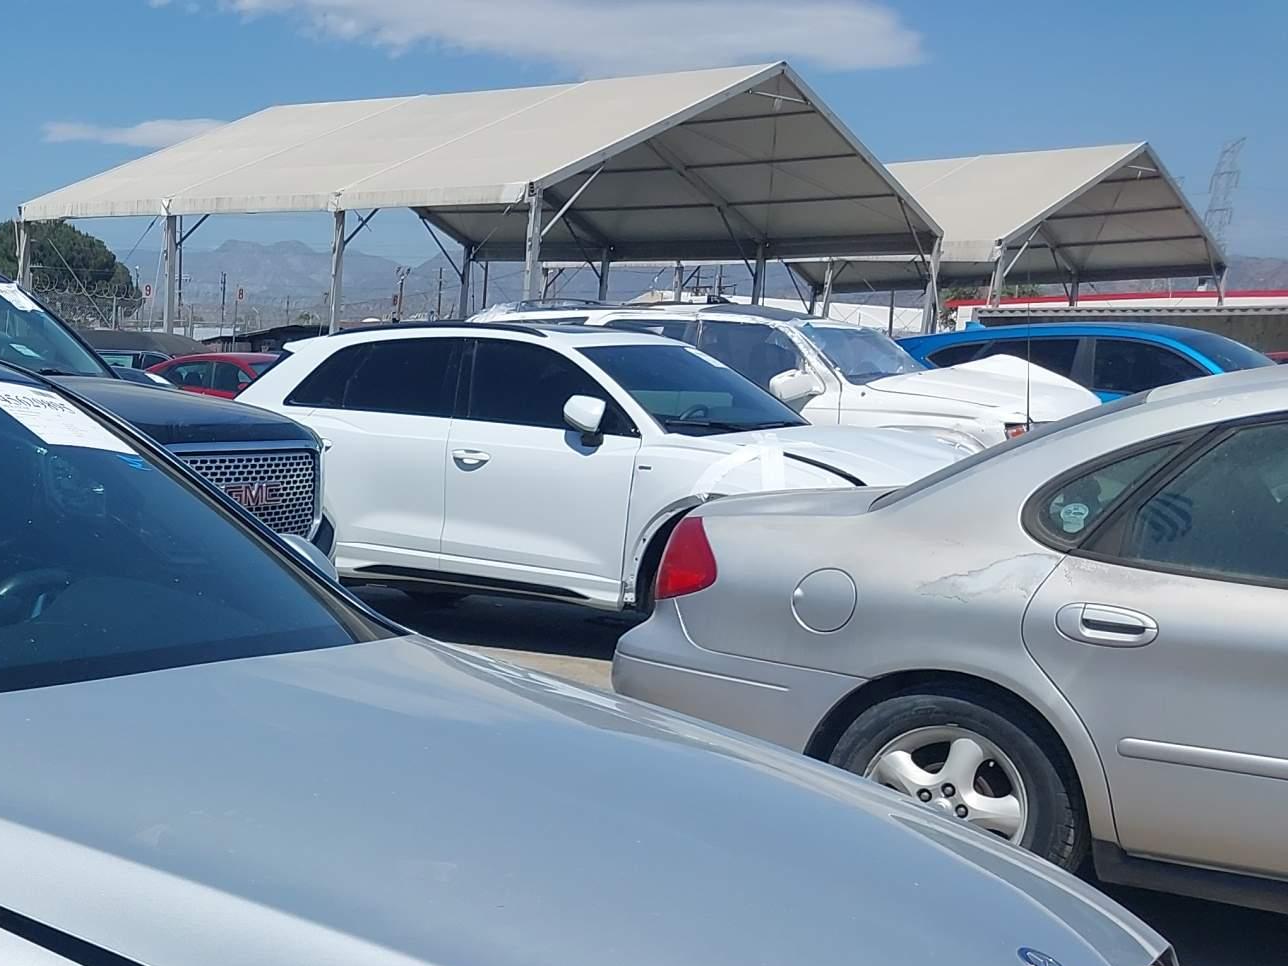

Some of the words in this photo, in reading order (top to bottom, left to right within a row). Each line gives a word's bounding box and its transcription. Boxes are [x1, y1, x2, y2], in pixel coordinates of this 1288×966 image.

[144, 284, 152, 297] 9
[238, 288, 244, 300] 8
[224, 482, 282, 506] GMC
